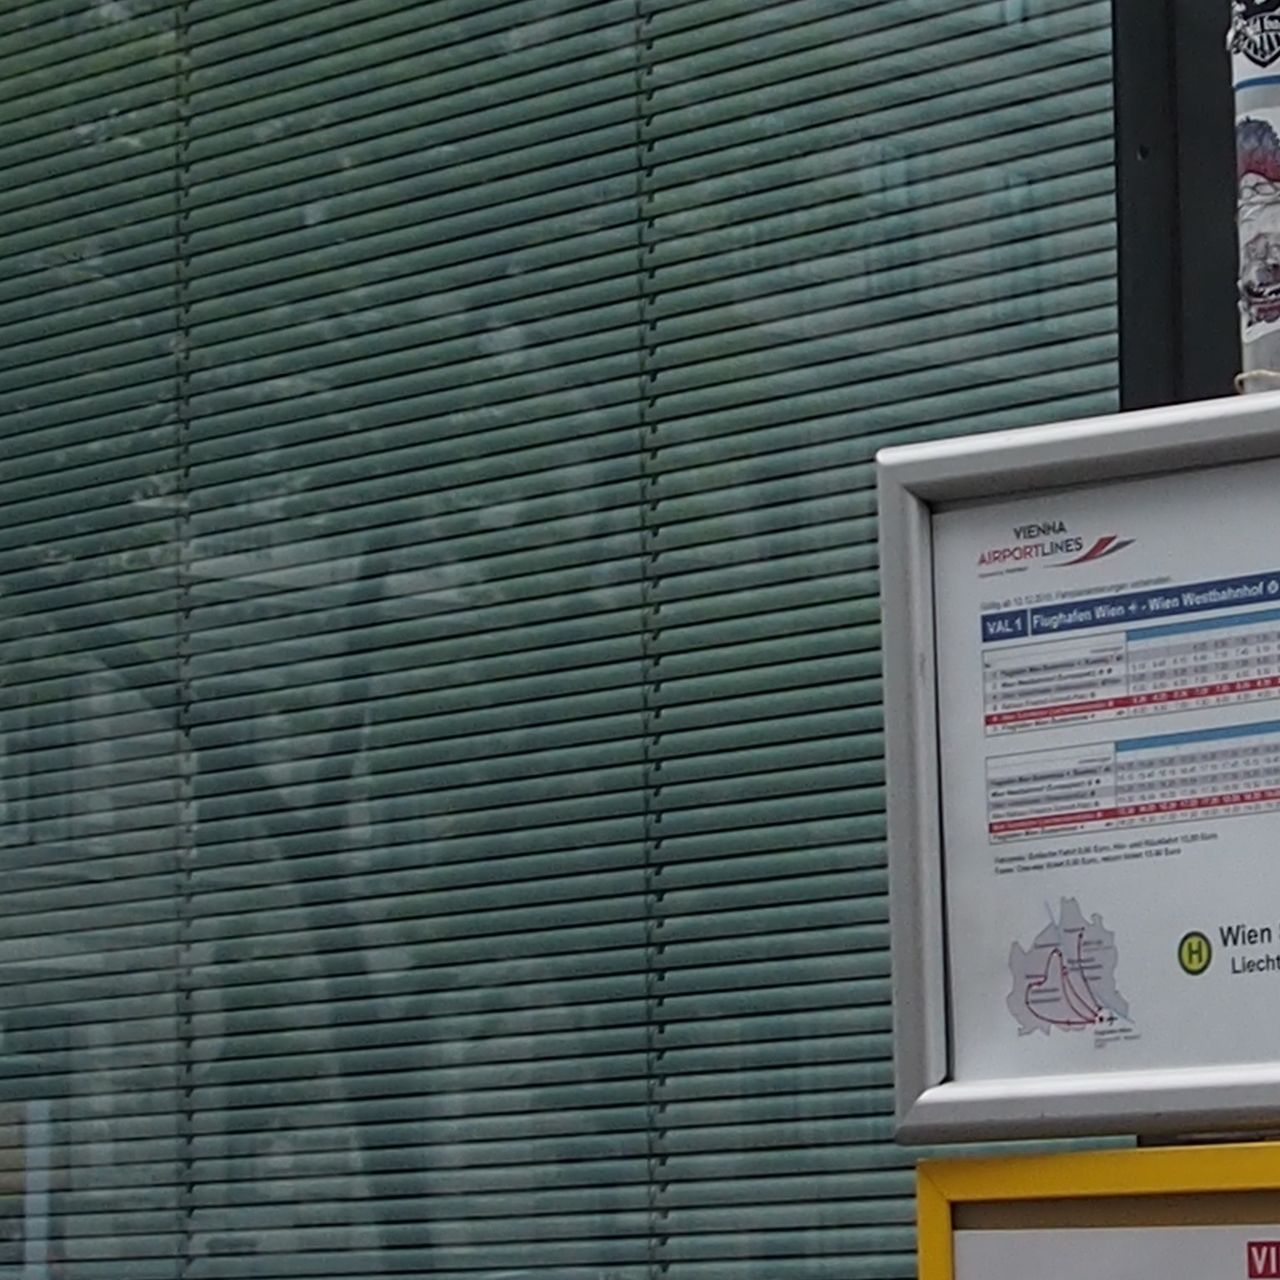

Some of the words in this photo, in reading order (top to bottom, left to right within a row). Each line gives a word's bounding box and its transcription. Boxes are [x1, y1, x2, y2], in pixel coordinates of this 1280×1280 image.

[1013, 521, 1067, 541] VIENNA
[978, 537, 1083, 566] AIRPORTLINES
[986, 618, 1013, 635] VAL
[1187, 940, 1203, 965] H
[1219, 923, 1272, 947] Wien
